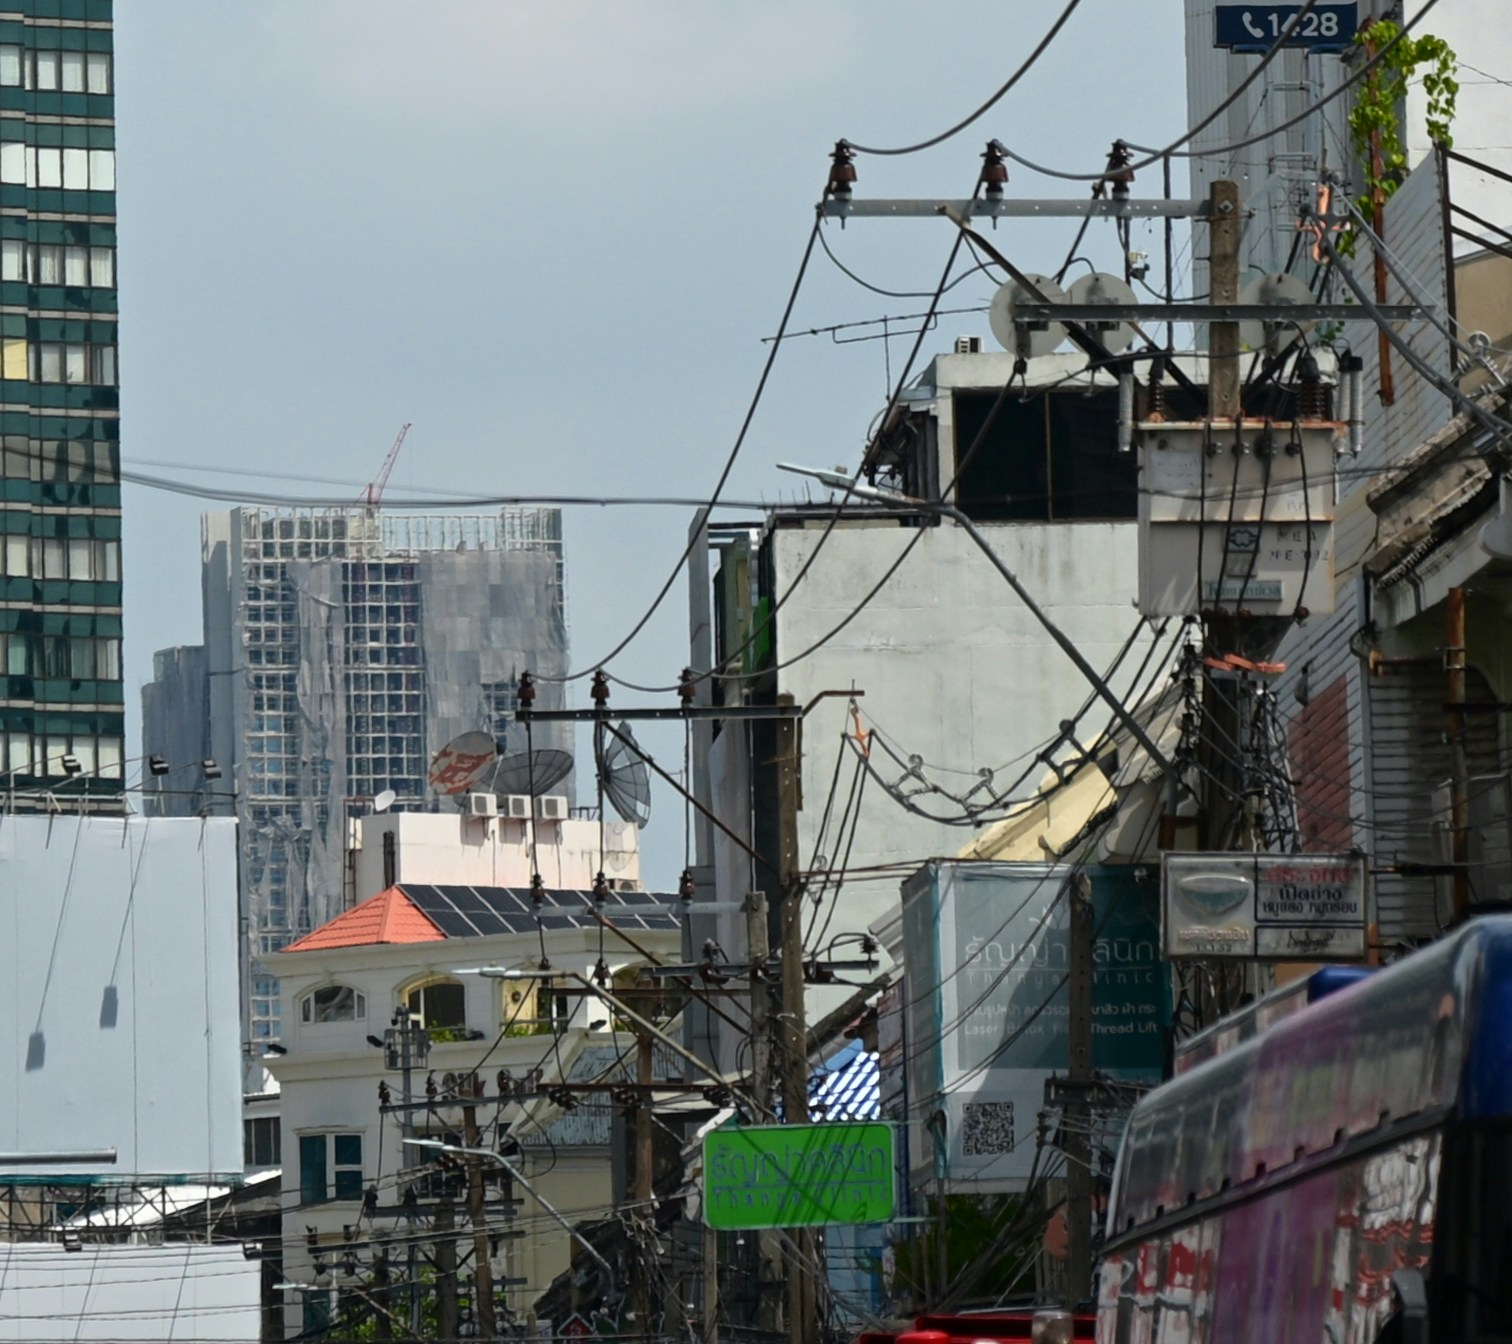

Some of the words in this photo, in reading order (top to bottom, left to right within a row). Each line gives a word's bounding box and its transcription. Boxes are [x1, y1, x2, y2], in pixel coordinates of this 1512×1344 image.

[1267, 11, 1339, 37] 1428
[1092, 970, 1156, 985] linic
[964, 1023, 999, 1036] Laser
[1136, 1019, 1158, 1033] Lift
